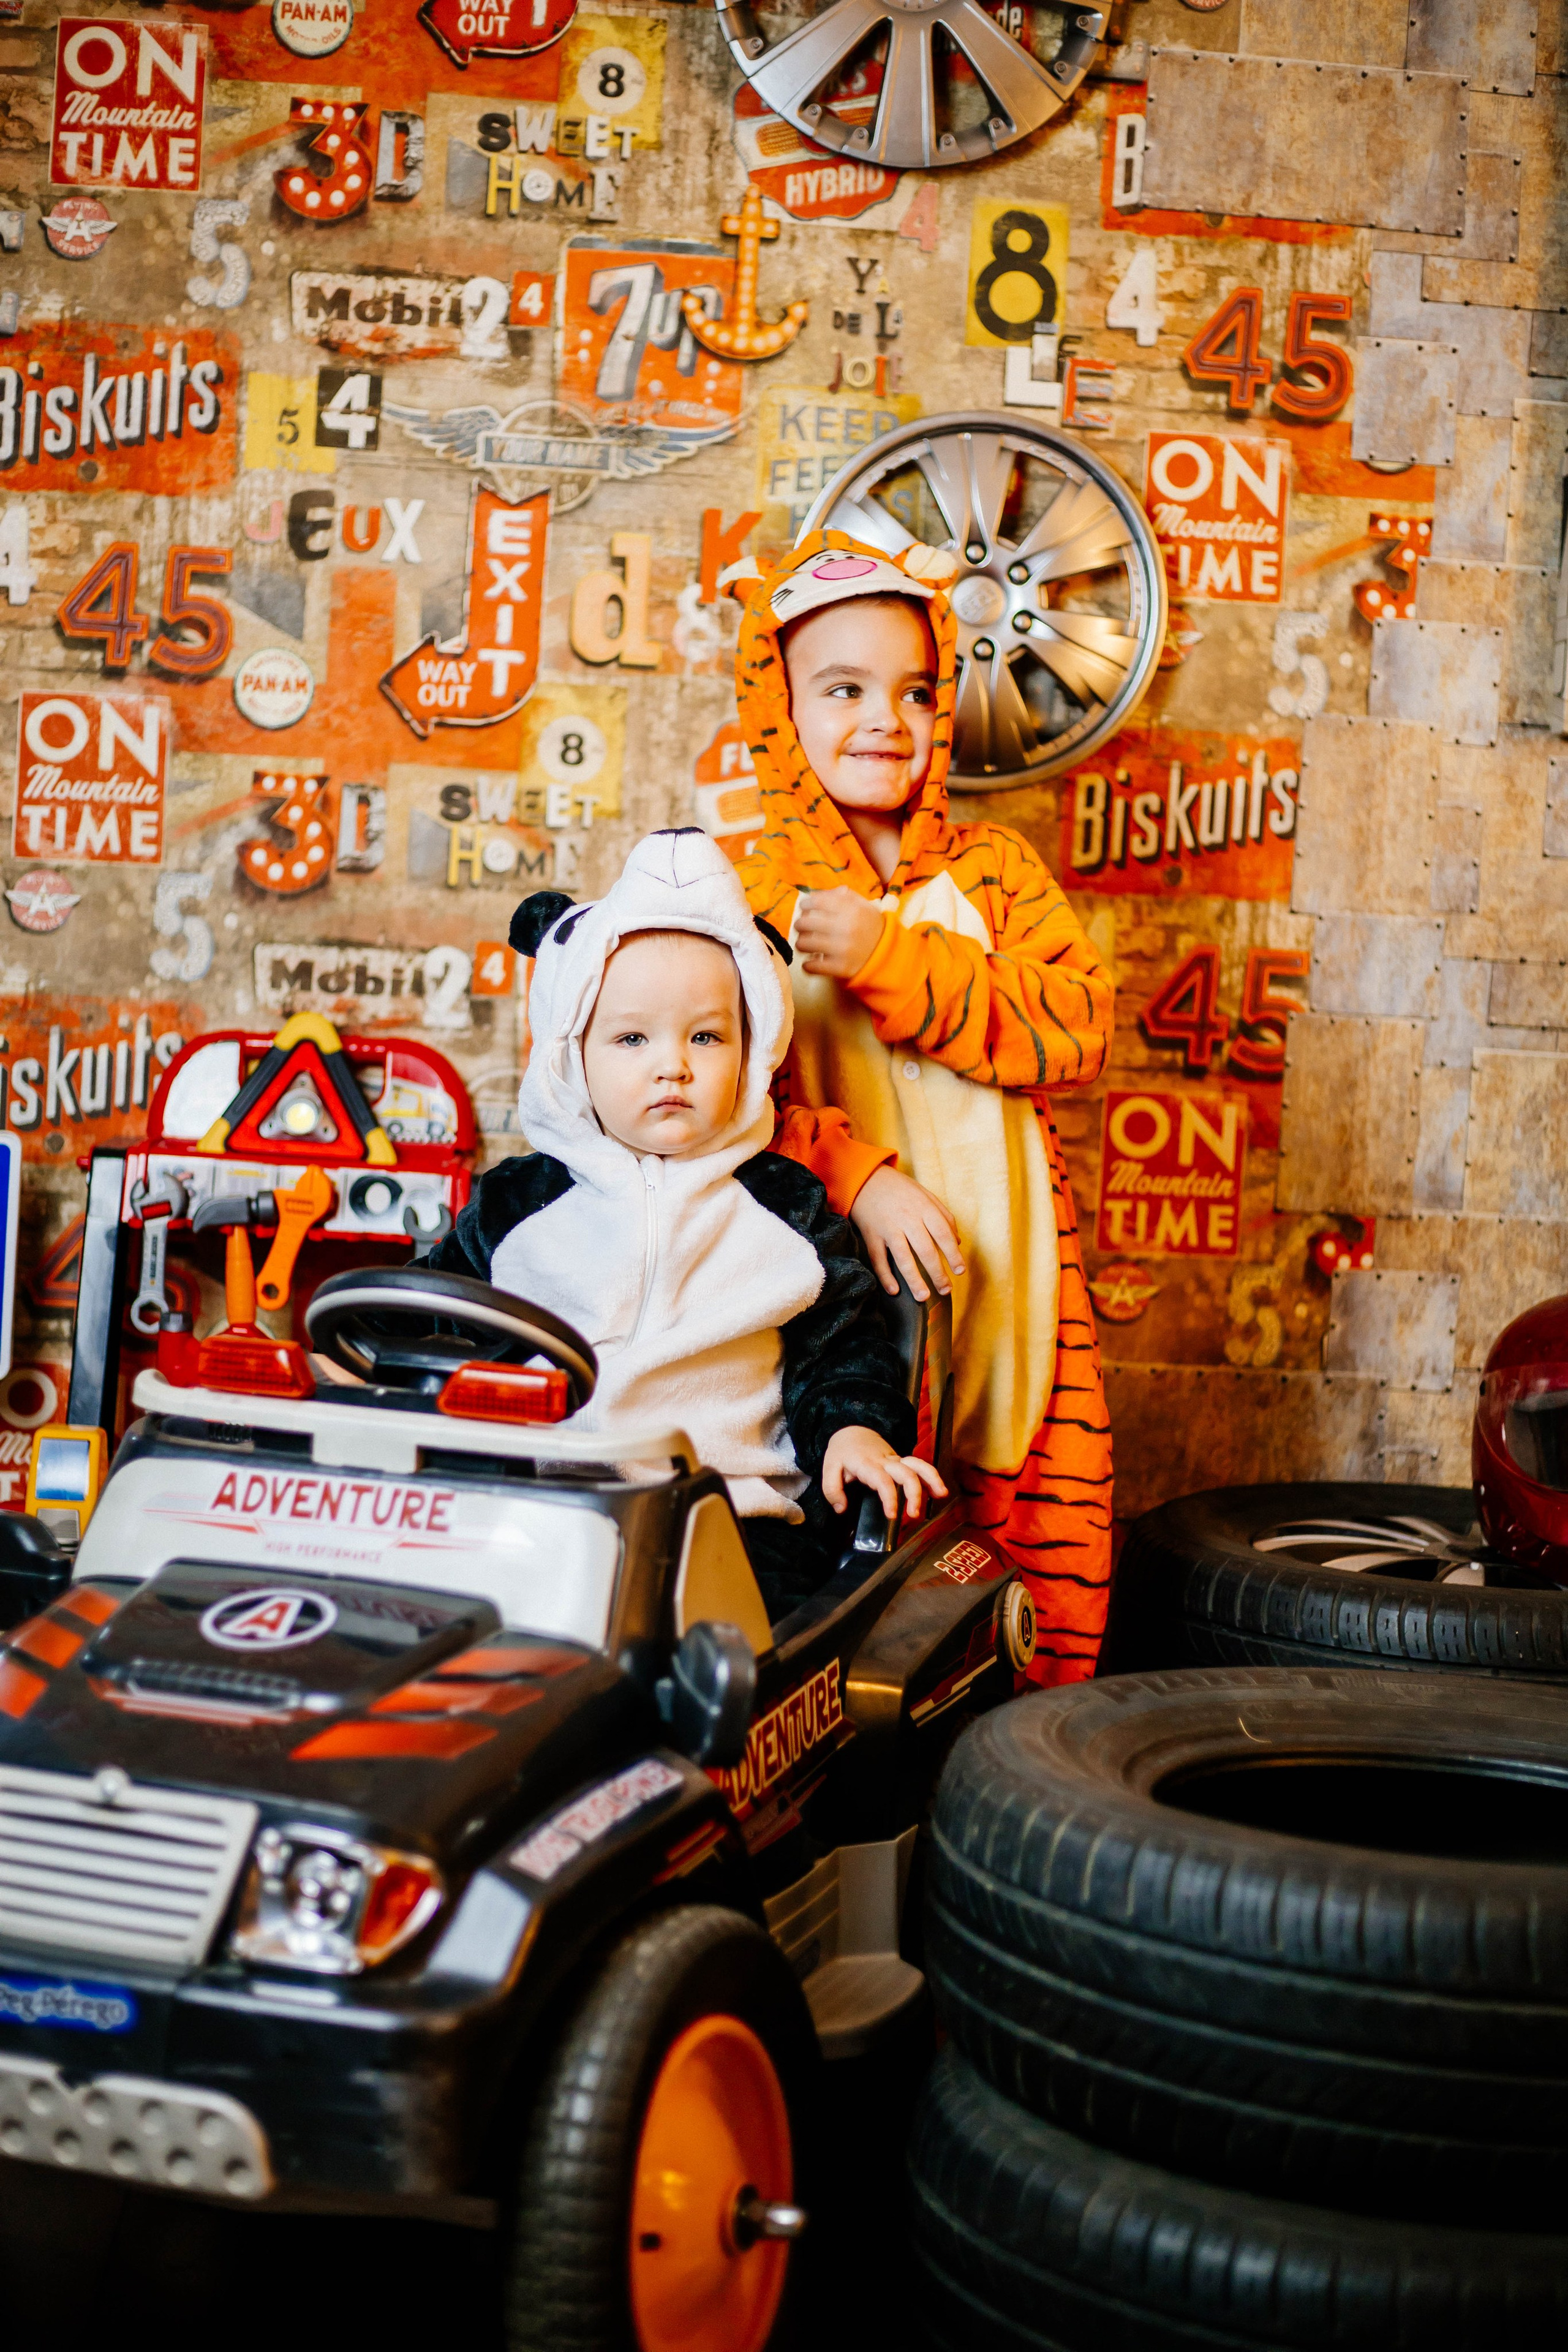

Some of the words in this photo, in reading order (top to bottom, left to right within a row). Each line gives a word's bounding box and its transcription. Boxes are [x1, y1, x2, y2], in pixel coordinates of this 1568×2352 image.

[281, 1, 347, 23] PAN-AM
[458, 13, 510, 37] OUT
[63, 26, 198, 103] ON
[598, 62, 625, 98] 8
[61, 91, 196, 130] Mountain
[478, 106, 639, 160] SWEET
[59, 131, 196, 183] TIME
[486, 154, 620, 222] HOME
[785, 164, 886, 207] HYBRID
[900, 183, 939, 252] 4
[186, 199, 249, 306] 5
[975, 209, 1058, 342] 8
[459, 276, 510, 358] 2
[518, 281, 544, 317] 4
[1106, 249, 1163, 346] 4
[1184, 287, 1353, 418] 45
[277, 408, 299, 445] 5
[320, 373, 376, 448] 4
[770, 454, 848, 495] FEE
[1151, 439, 1282, 518] ON
[246, 490, 425, 563] JEUX
[1152, 502, 1280, 544] Mountain
[58, 541, 233, 674] 45
[478, 509, 533, 697] EXIT
[571, 532, 662, 668] d
[418, 660, 477, 684] WAY
[418, 684, 472, 707] OUT
[1268, 612, 1329, 718] 5
[25, 698, 160, 777] ON
[561, 733, 586, 766] 8
[24, 763, 160, 805] Mountain
[440, 775, 600, 828] SWEET
[21, 805, 159, 858] TIME
[447, 826, 586, 888] HOME
[149, 872, 214, 980] 5
[422, 946, 472, 1030] 2
[480, 951, 507, 987] 4
[1140, 945, 1310, 1071] 45
[1109, 1096, 1238, 1172] ON
[1104, 1159, 1235, 1199] Mountain
[1104, 1199, 1235, 1249] TIME
[211, 1472, 454, 1532] ADVENTURE
